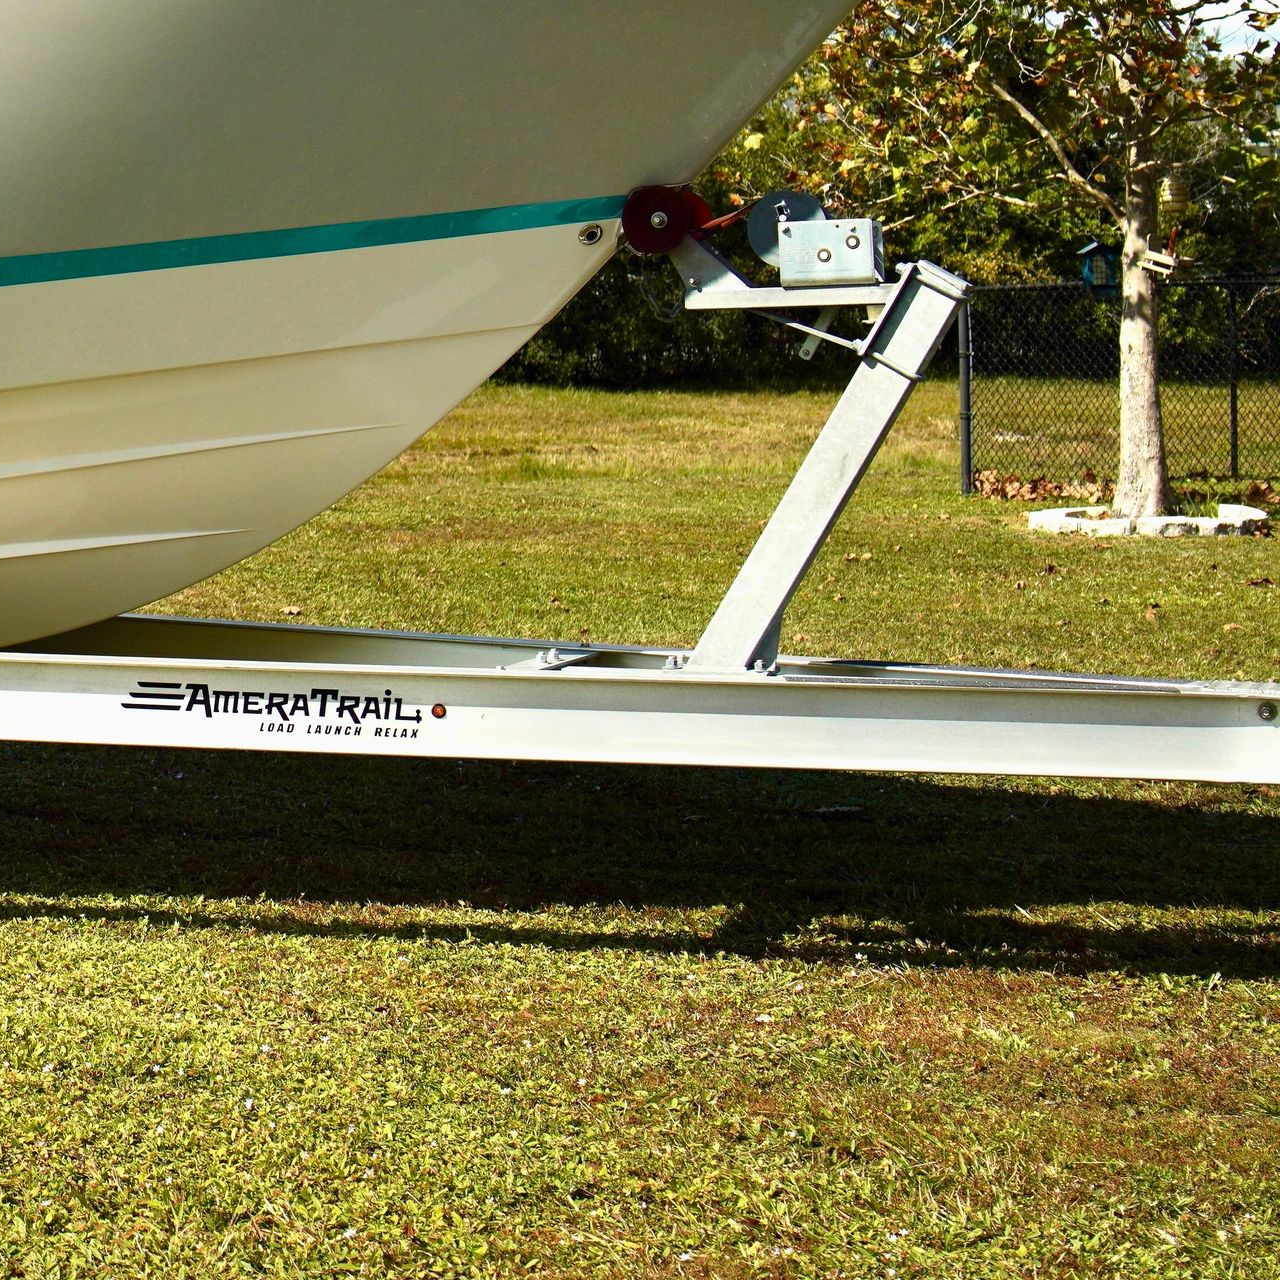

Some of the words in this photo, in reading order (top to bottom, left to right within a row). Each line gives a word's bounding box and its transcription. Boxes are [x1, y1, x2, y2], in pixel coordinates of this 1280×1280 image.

[259, 722, 295, 734] LOAD
[307, 723, 363, 737] LAUNCH
[374, 726, 420, 739] RELAX
